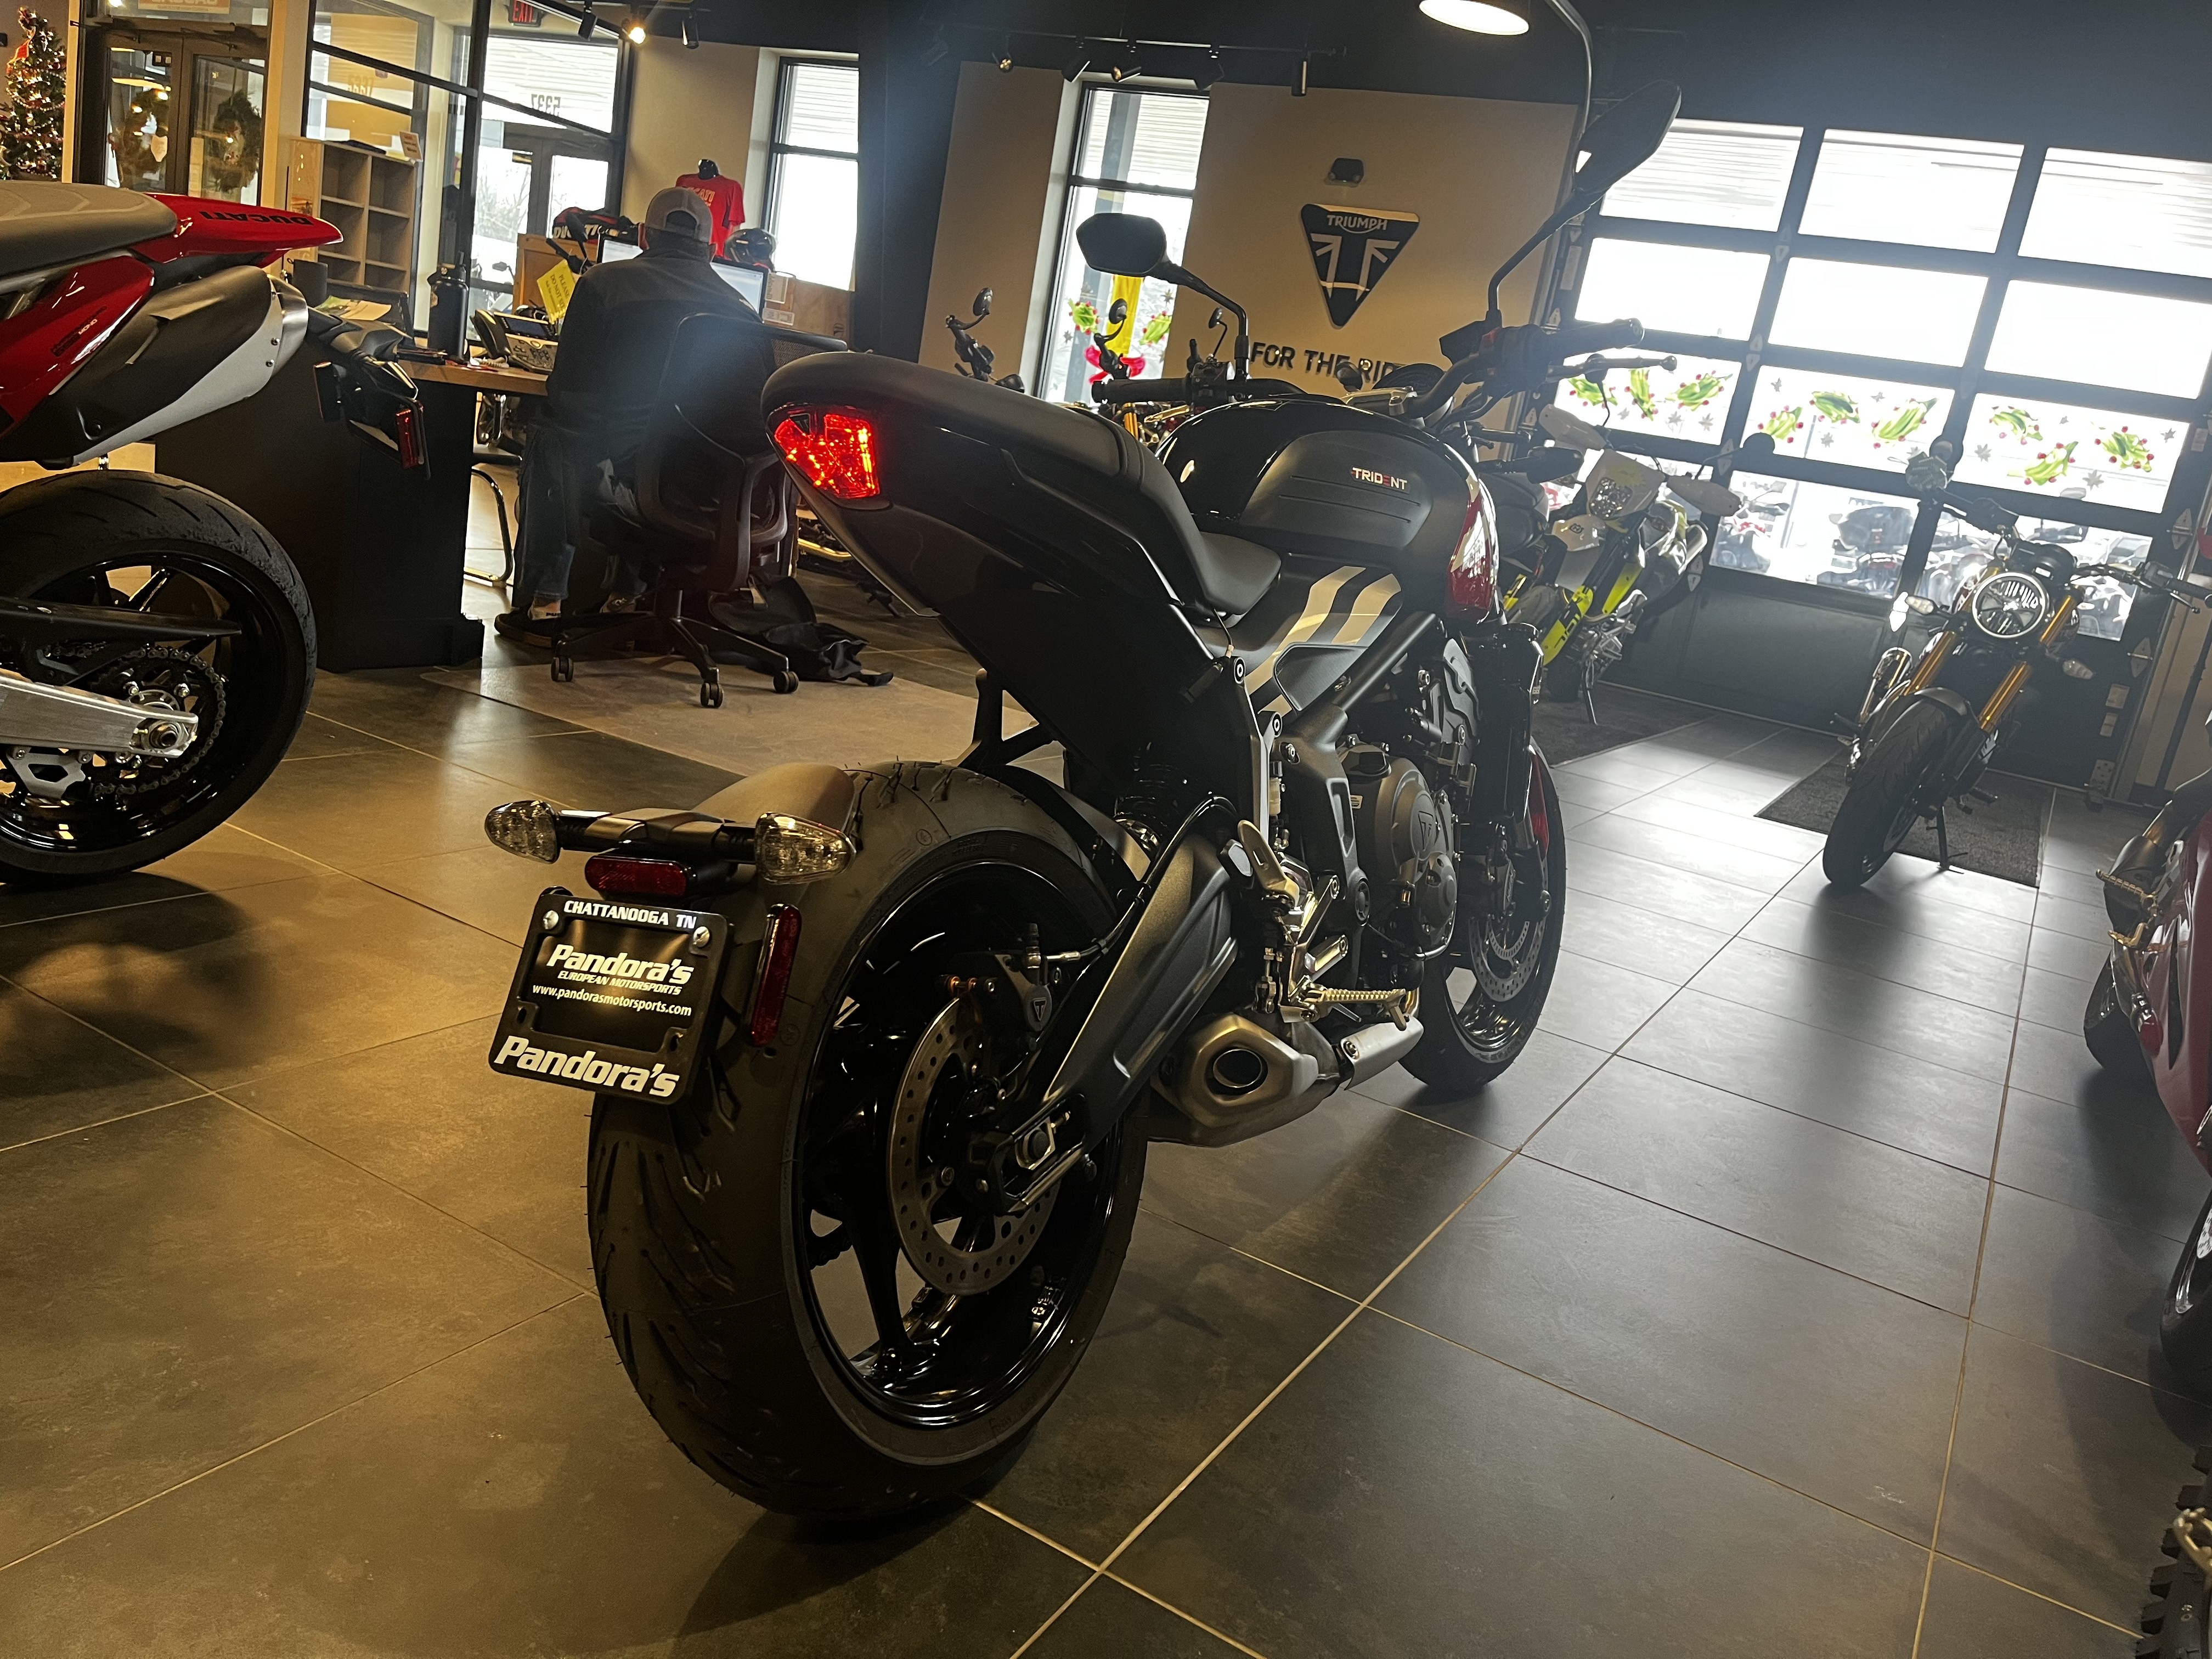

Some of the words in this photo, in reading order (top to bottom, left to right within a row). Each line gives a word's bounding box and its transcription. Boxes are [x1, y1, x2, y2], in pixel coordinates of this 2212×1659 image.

[199, 211, 314, 226] DUCATI
[1327, 214, 1388, 234] TRIUMPH
[552, 224, 600, 239] DUTI
[78, 319, 98, 335] MONO
[1250, 342, 1295, 369] FOR
[1358, 358, 1401, 383] RID
[1352, 467, 1408, 490] TRIDENT
[563, 900, 669, 926] CHATTANOOGA
[676, 915, 696, 929] TN
[546, 944, 695, 984] Pandora's
[557, 970, 610, 986] EUROPEAN
[610, 978, 682, 995] MOTORSPORTS
[533, 985, 692, 1017] www.pandorasmotorsports.com
[494, 1035, 680, 1098] Pandora's
